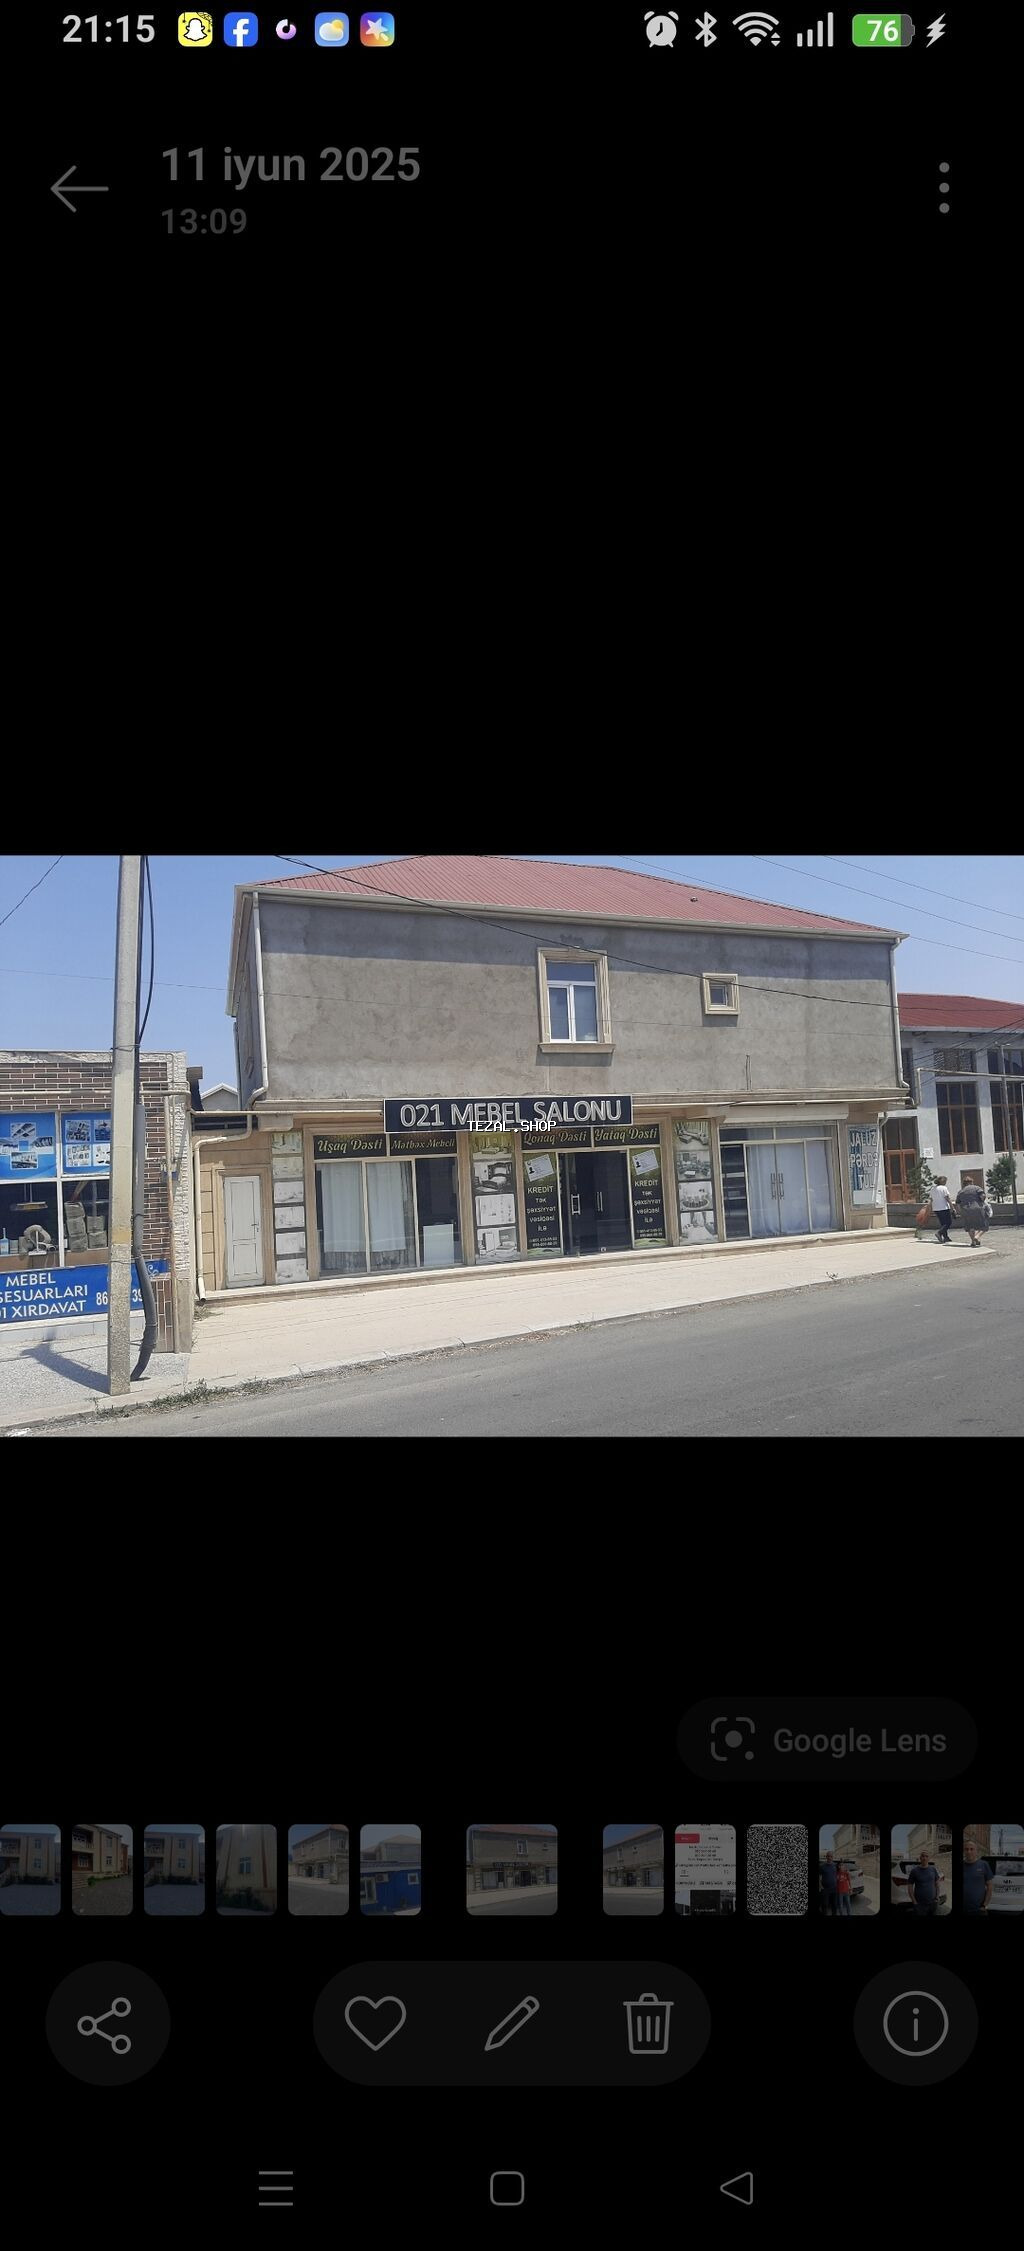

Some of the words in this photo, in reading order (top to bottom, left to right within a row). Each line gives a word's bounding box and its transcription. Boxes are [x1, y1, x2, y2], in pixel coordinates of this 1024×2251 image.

[62, 15, 155, 43] 21:15
[866, 20, 899, 41] 76
[162, 148, 204, 181] 11
[223, 147, 305, 190] iyun
[319, 147, 420, 182] 2025
[161, 208, 247, 234] 13:09
[400, 1103, 444, 1127] 021
[451, 1101, 527, 1126] MEBEL
[533, 1099, 622, 1123] SALONU
[317, 1139, 348, 1153] Uşaq
[6, 1273, 56, 1287] MEBEL
[12, 1300, 87, 1319] XIRDAVAT
[774, 1728, 872, 1758] Google
[881, 1728, 947, 1752] Lens
